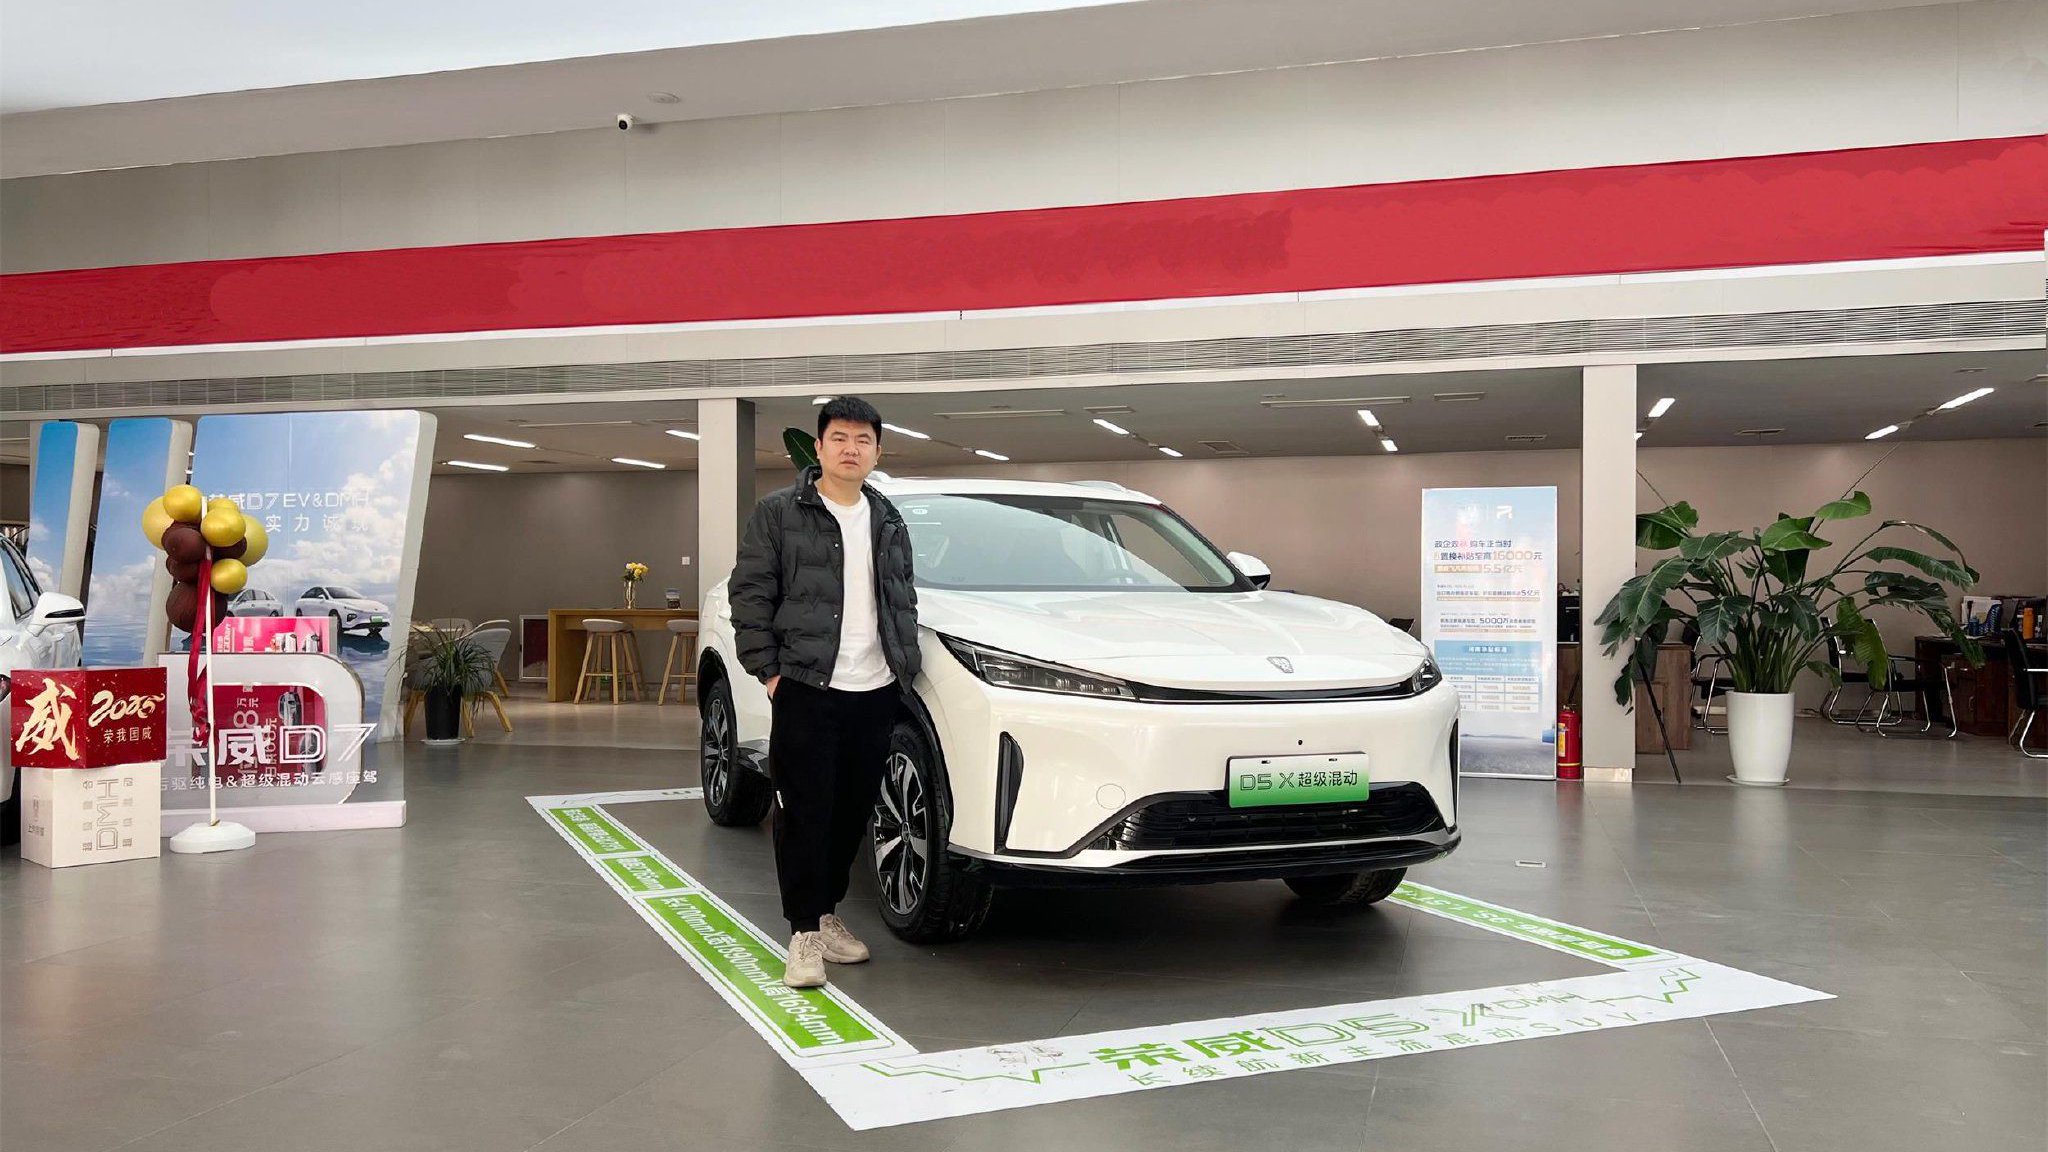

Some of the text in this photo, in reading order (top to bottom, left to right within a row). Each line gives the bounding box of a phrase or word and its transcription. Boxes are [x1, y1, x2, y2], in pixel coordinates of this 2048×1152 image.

[15, 677, 80, 761] 威
[88, 690, 166, 728] 2025
[103, 726, 152, 744] 荣我国威
[167, 722, 378, 767] 荣威D7
[96, 778, 119, 851] DMH
